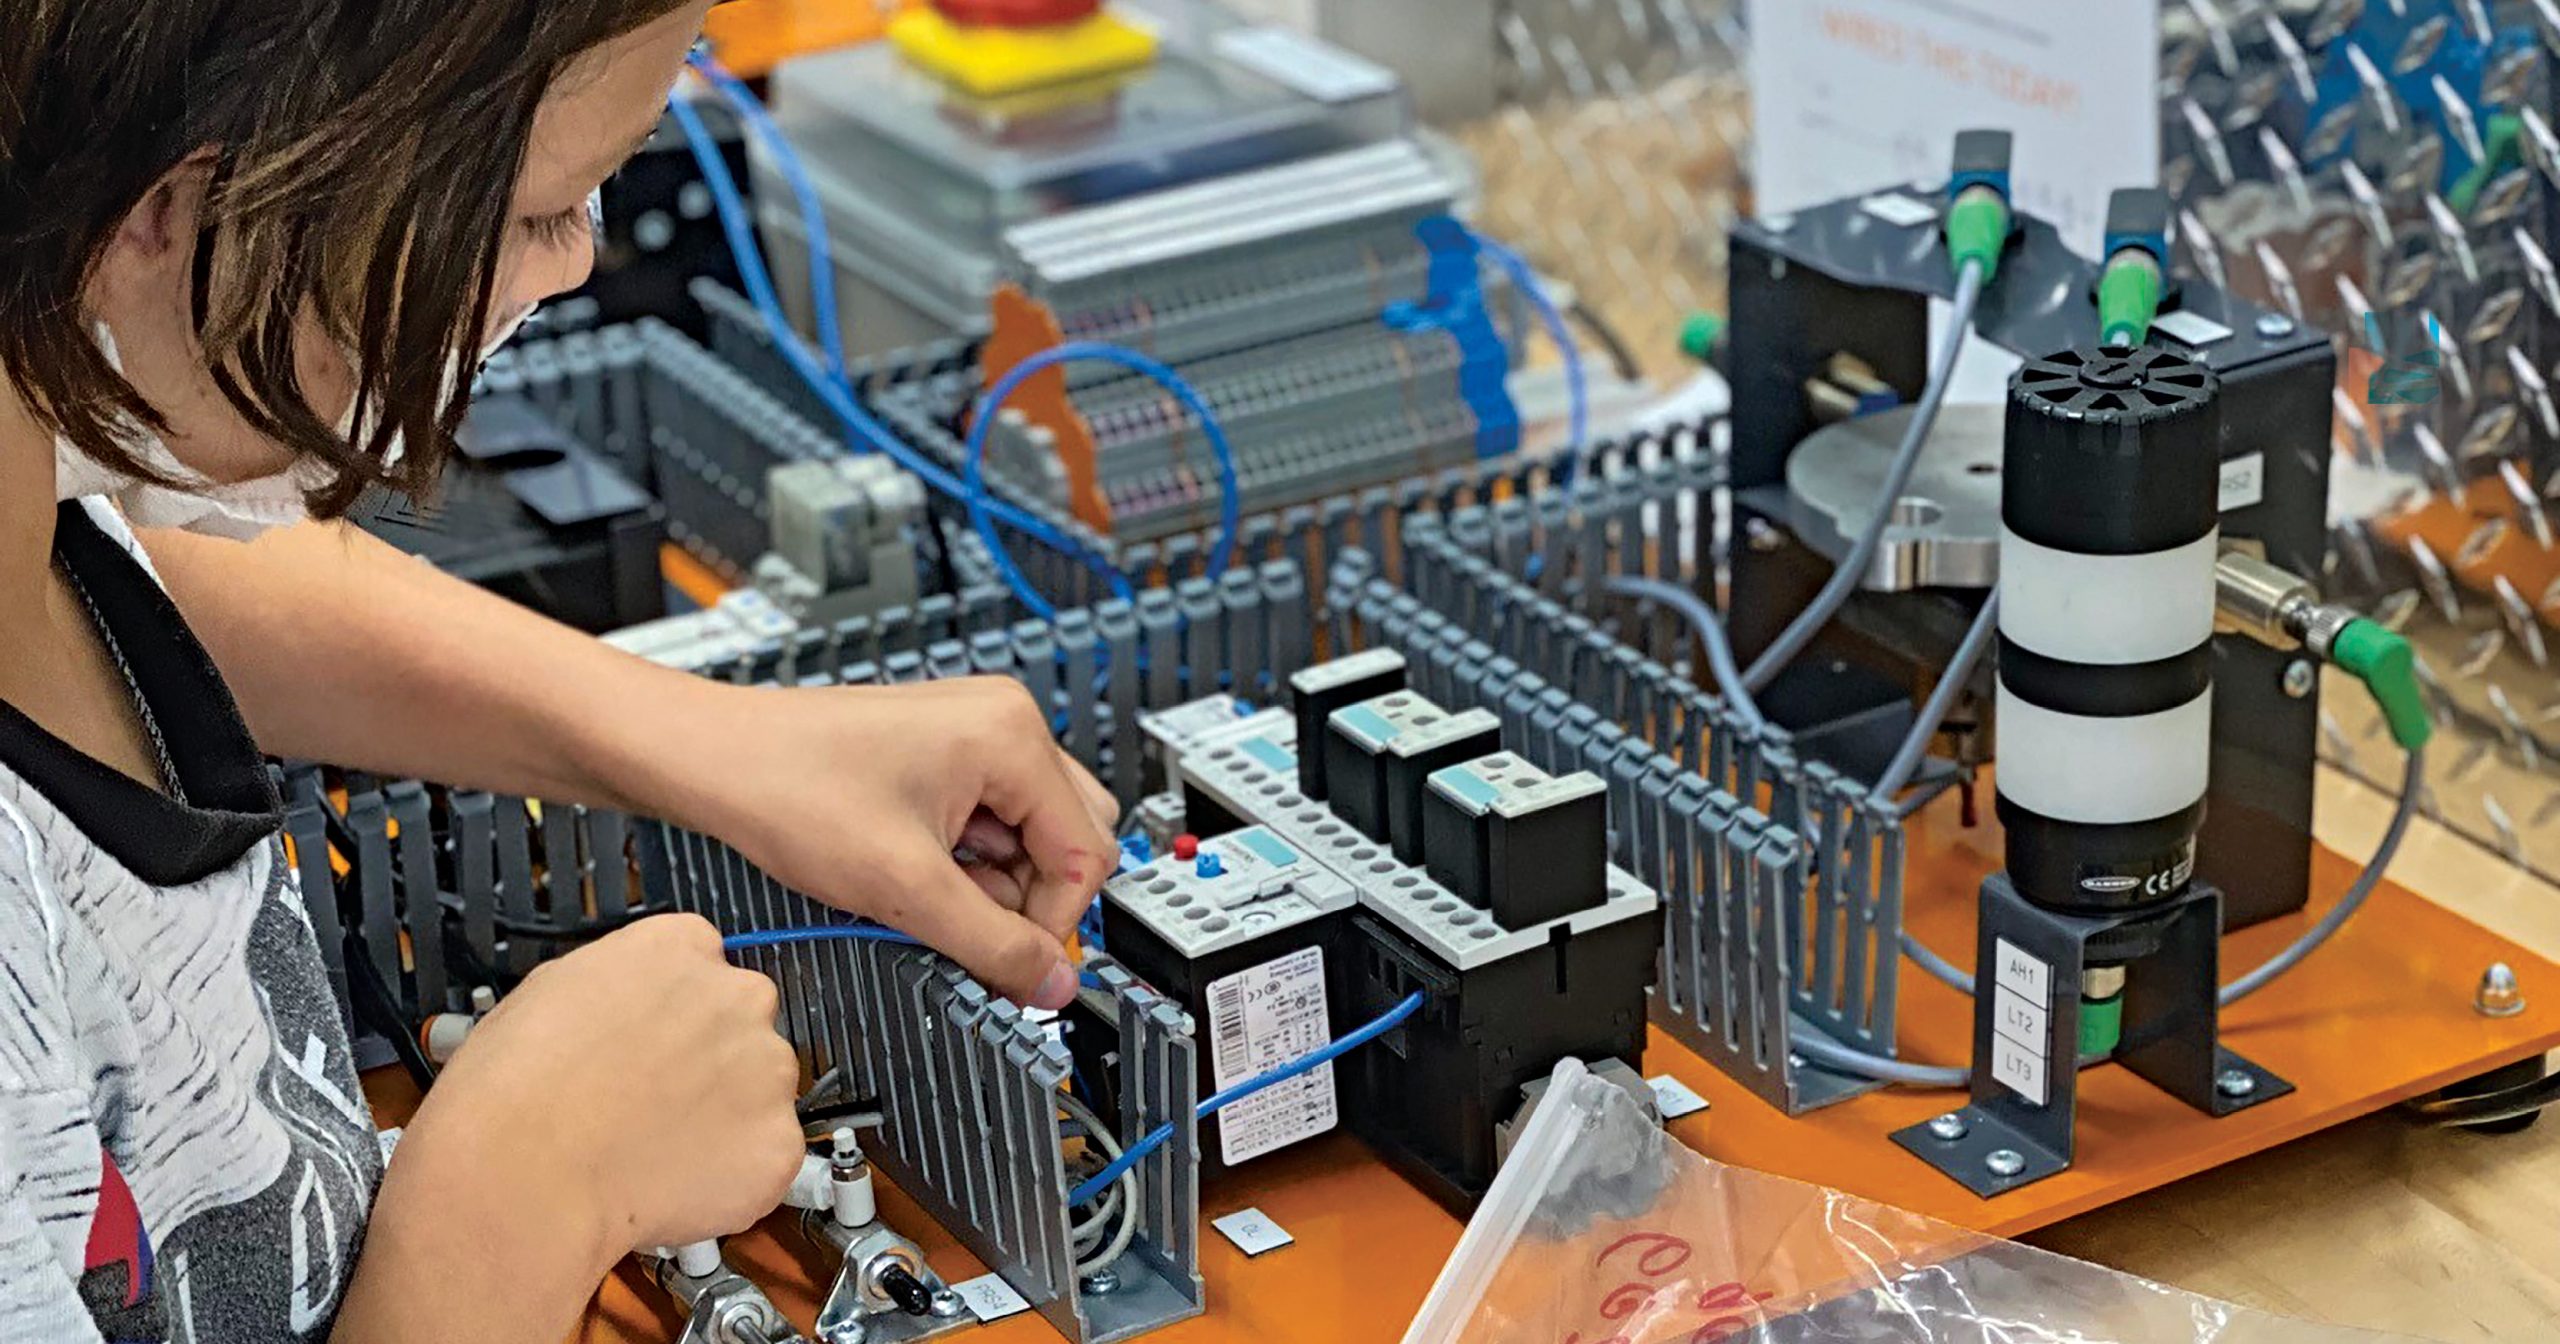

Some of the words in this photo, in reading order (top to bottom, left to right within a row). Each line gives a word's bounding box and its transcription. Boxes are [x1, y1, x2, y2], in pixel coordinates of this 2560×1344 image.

[2010, 959, 2034, 985] AH1
[2008, 1005, 2034, 1034] LT2
[2006, 1053, 2032, 1081] LT3
